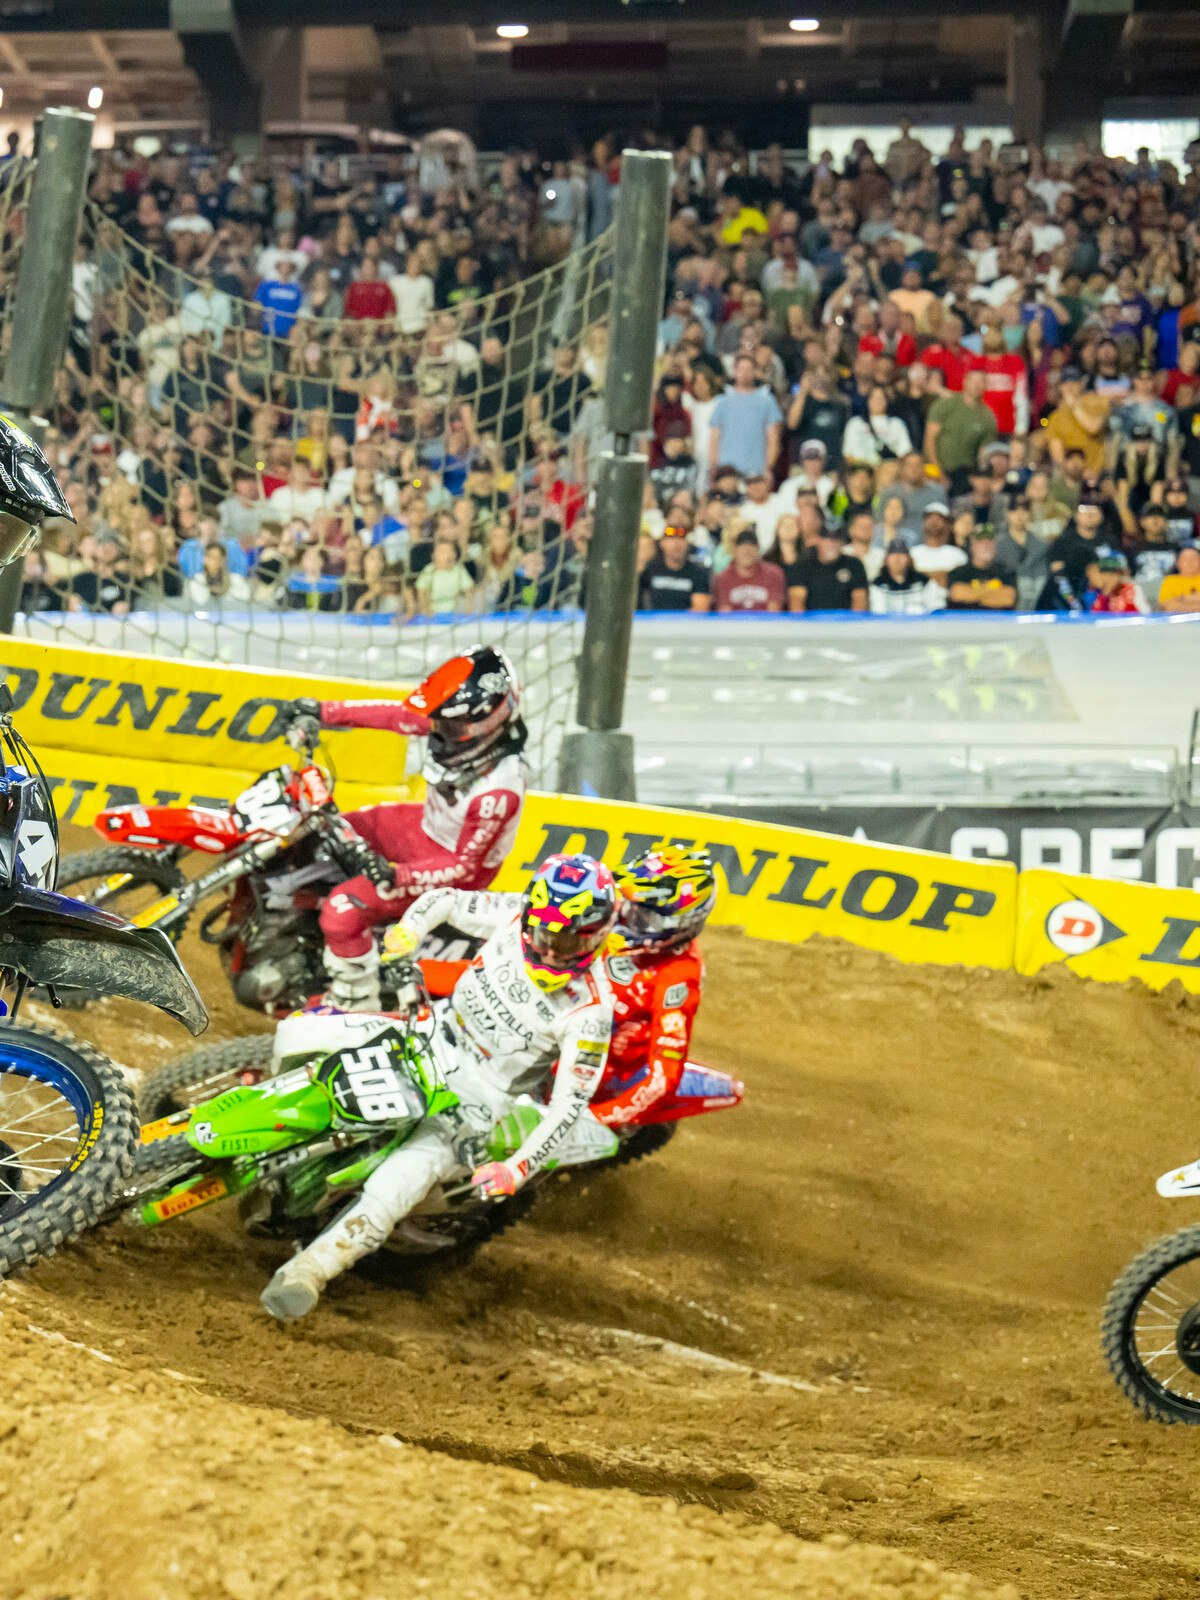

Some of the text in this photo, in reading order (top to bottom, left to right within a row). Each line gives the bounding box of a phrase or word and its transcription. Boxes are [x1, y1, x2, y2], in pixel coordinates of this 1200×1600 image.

[235, 778, 292, 834] 84
[478, 794, 508, 820] 84
[221, 1139, 250, 1151] FIST
